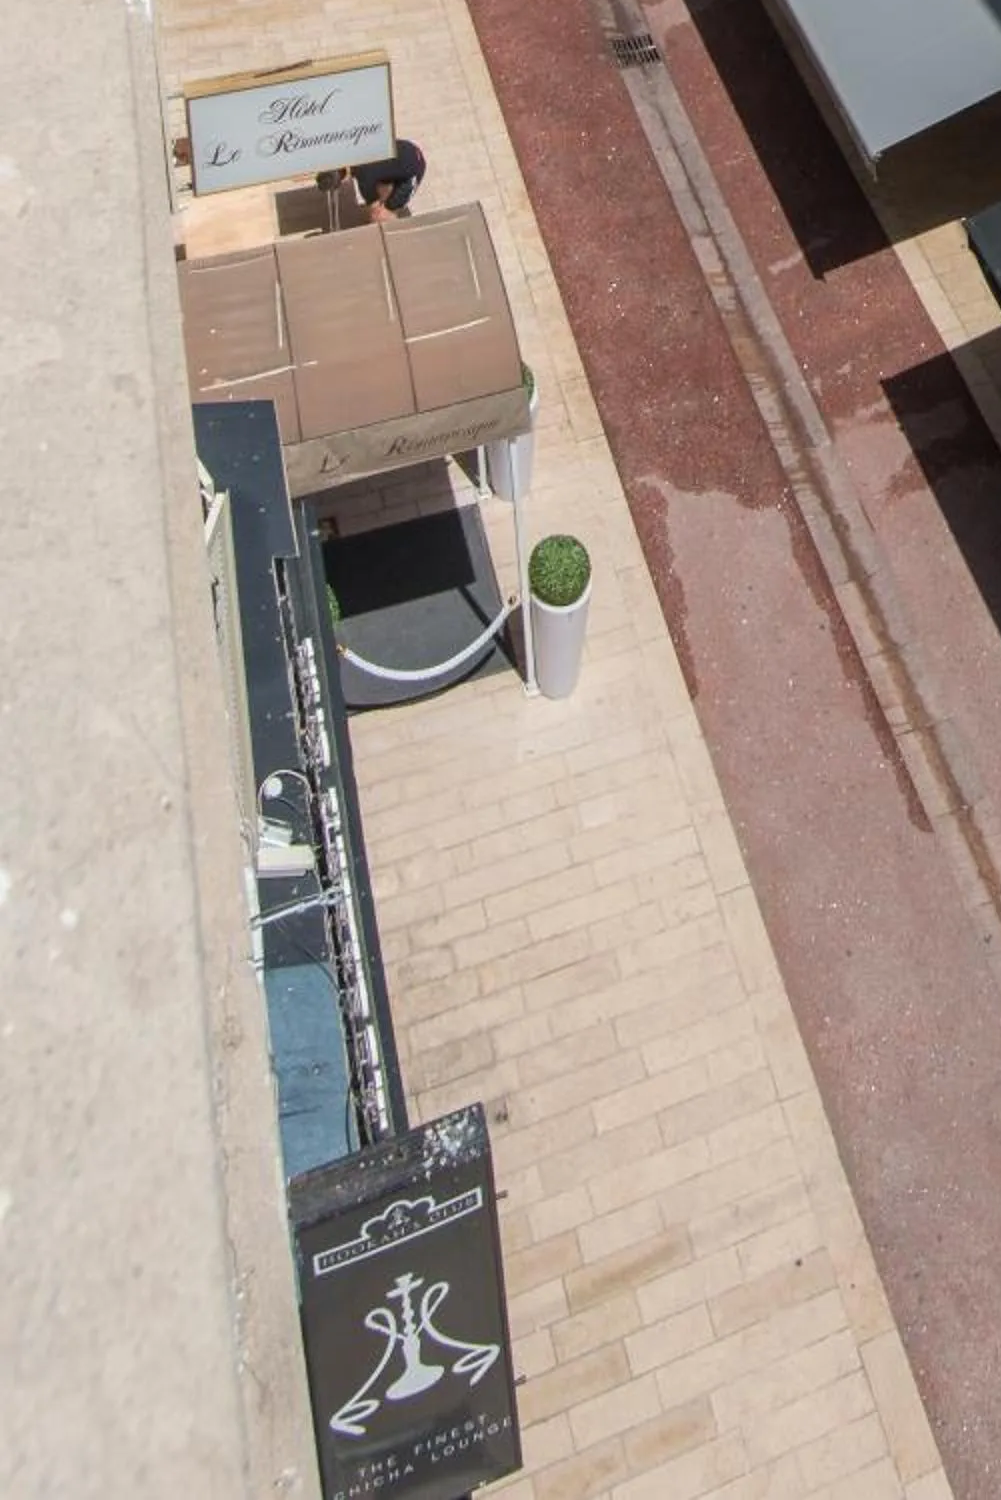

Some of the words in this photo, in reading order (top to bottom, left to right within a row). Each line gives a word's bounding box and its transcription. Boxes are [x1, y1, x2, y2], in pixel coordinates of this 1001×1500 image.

[202, 141, 242, 168] Le
[358, 1454, 398, 1478] THE
[413, 1412, 489, 1456] FINEST
[430, 1414, 512, 1463] LOUNGE
